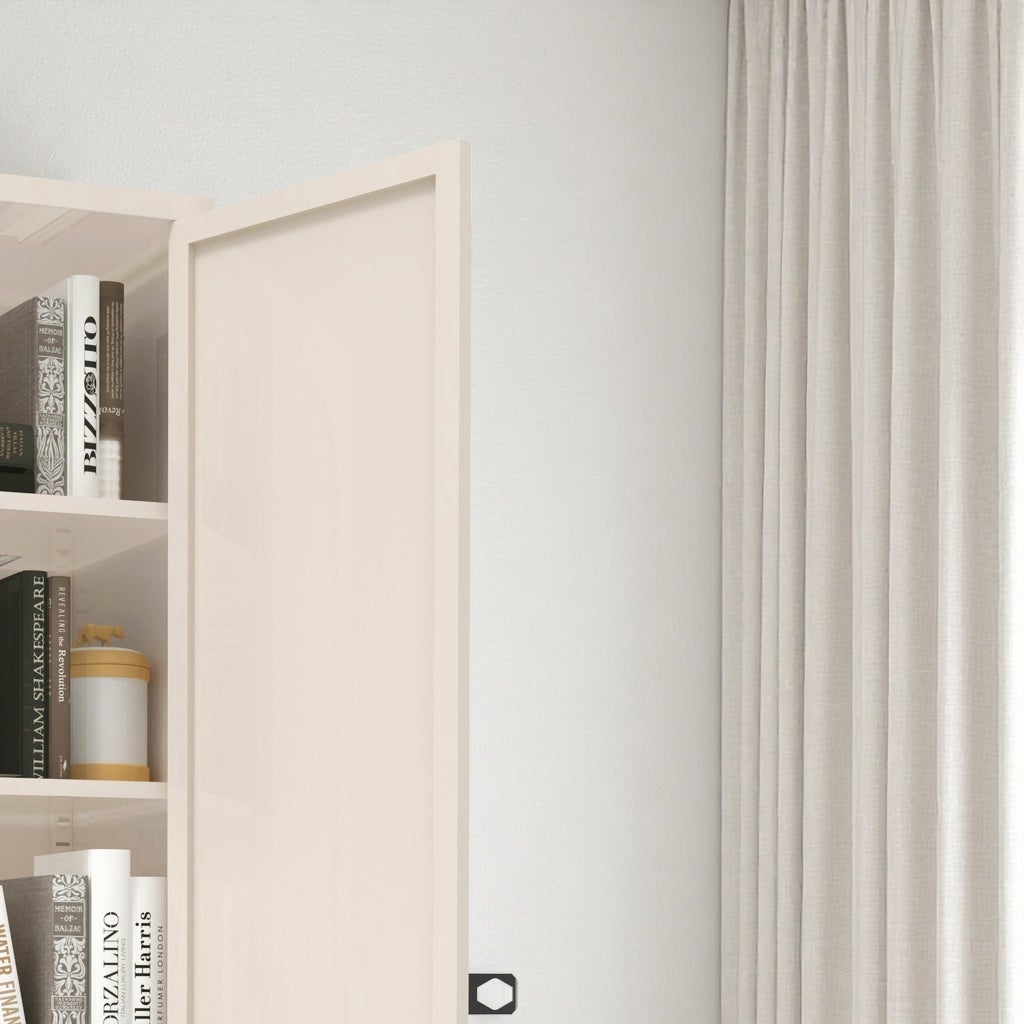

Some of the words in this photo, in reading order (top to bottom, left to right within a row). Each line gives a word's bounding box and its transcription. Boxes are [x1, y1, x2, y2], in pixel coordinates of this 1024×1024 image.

[39, 327, 63, 336] MEMOIR
[39, 346, 62, 354] BALZAC
[58, 586, 66, 633] REVEALING
[33, 576, 45, 701] SHAKESPEARE
[58, 649, 67, 702] Revolution
[54, 905, 83, 913] MEMOIR
[54, 924, 82, 932] BALZAC
[134, 911, 152, 979] Harris
